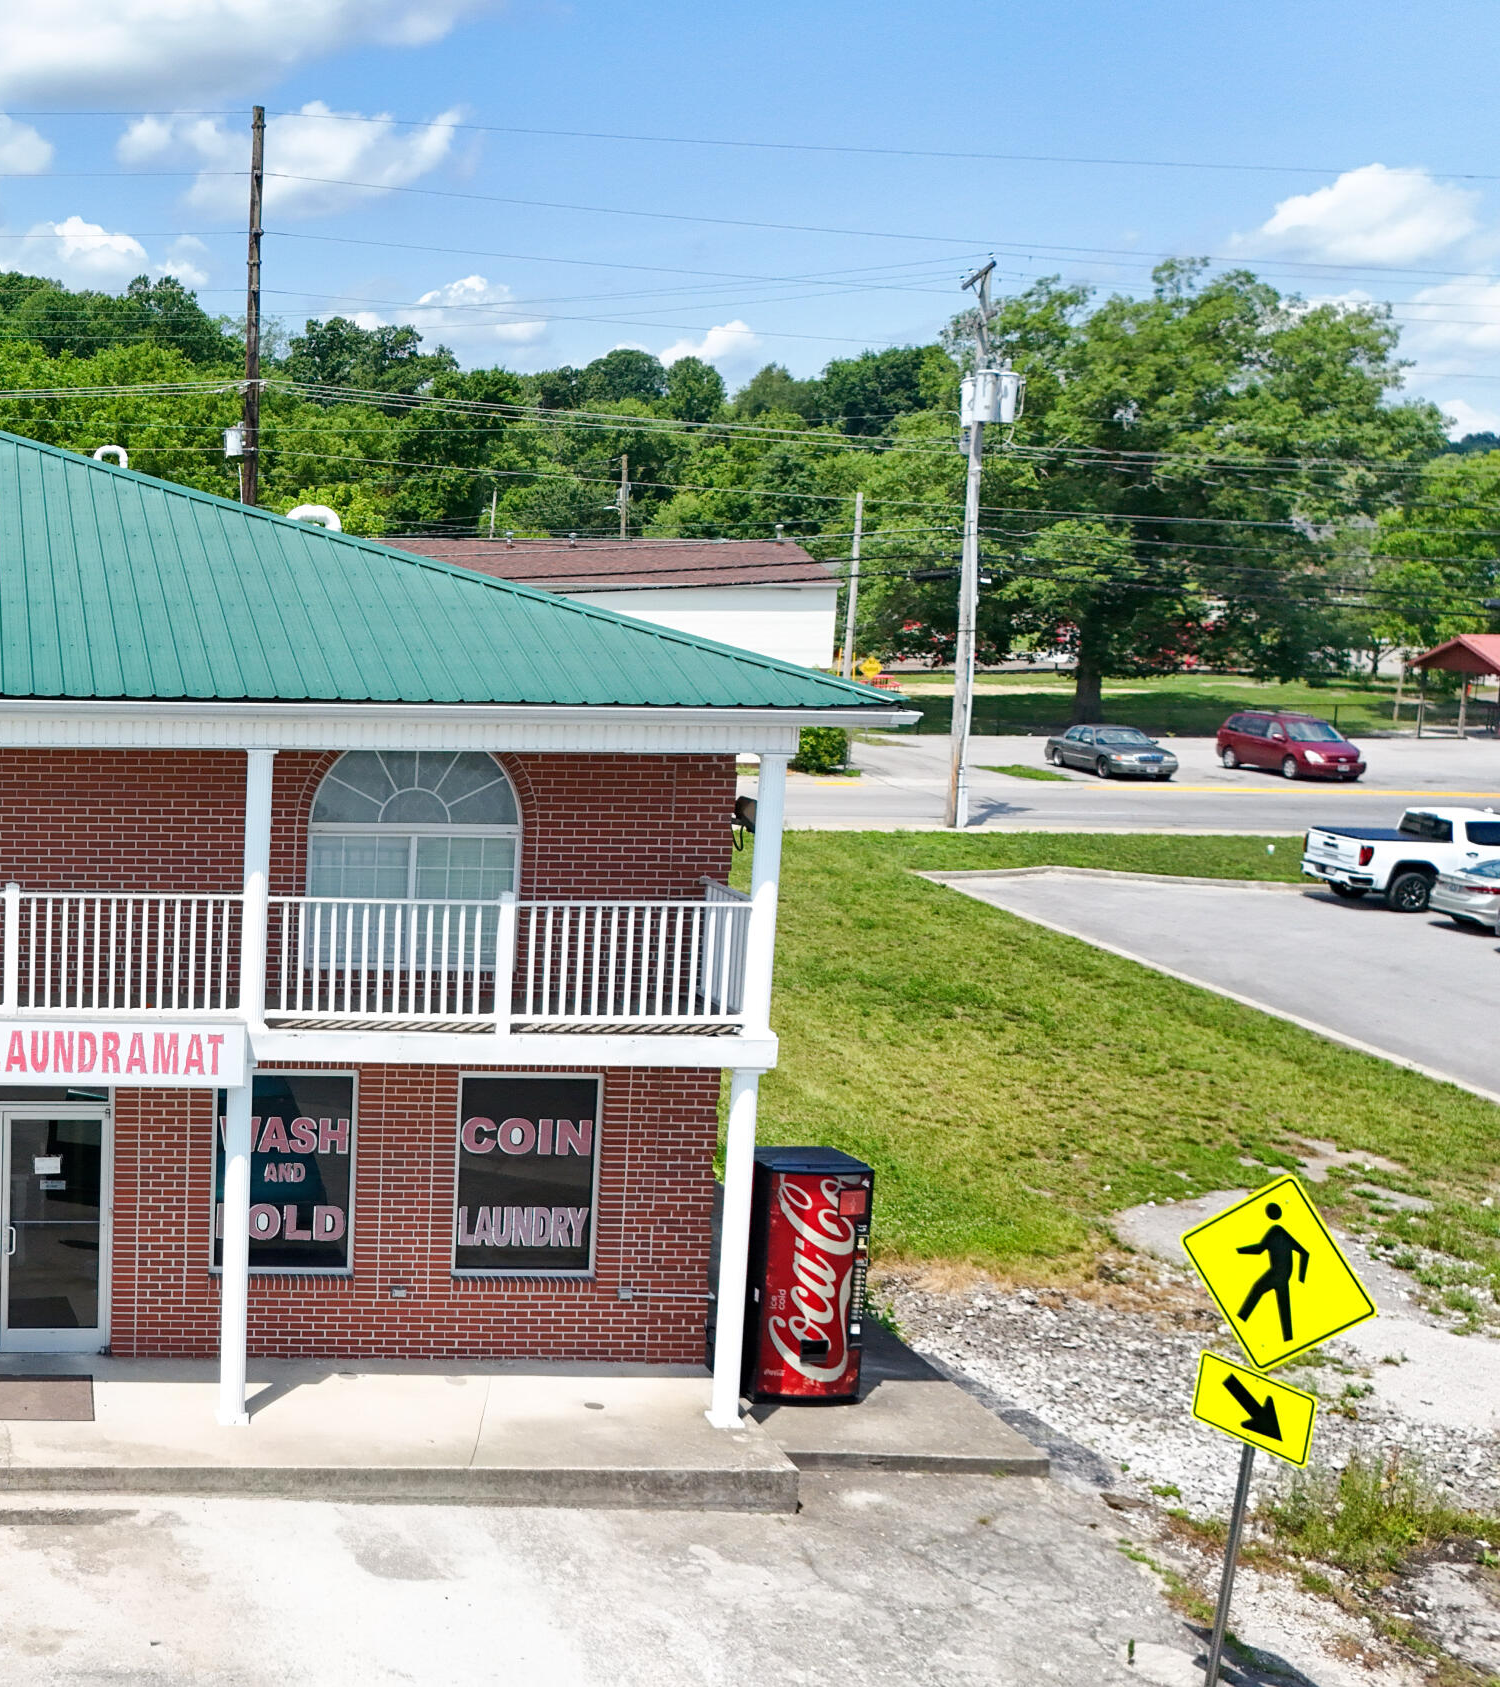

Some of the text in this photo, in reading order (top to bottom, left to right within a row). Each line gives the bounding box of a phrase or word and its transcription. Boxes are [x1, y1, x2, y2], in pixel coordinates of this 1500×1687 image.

[461, 1117, 593, 1156] COIN
[264, 1162, 306, 1183] AND
[216, 1203, 347, 1241] OLD
[457, 1205, 590, 1248] LAUNDRY
[778, 1288, 787, 1311] cold
